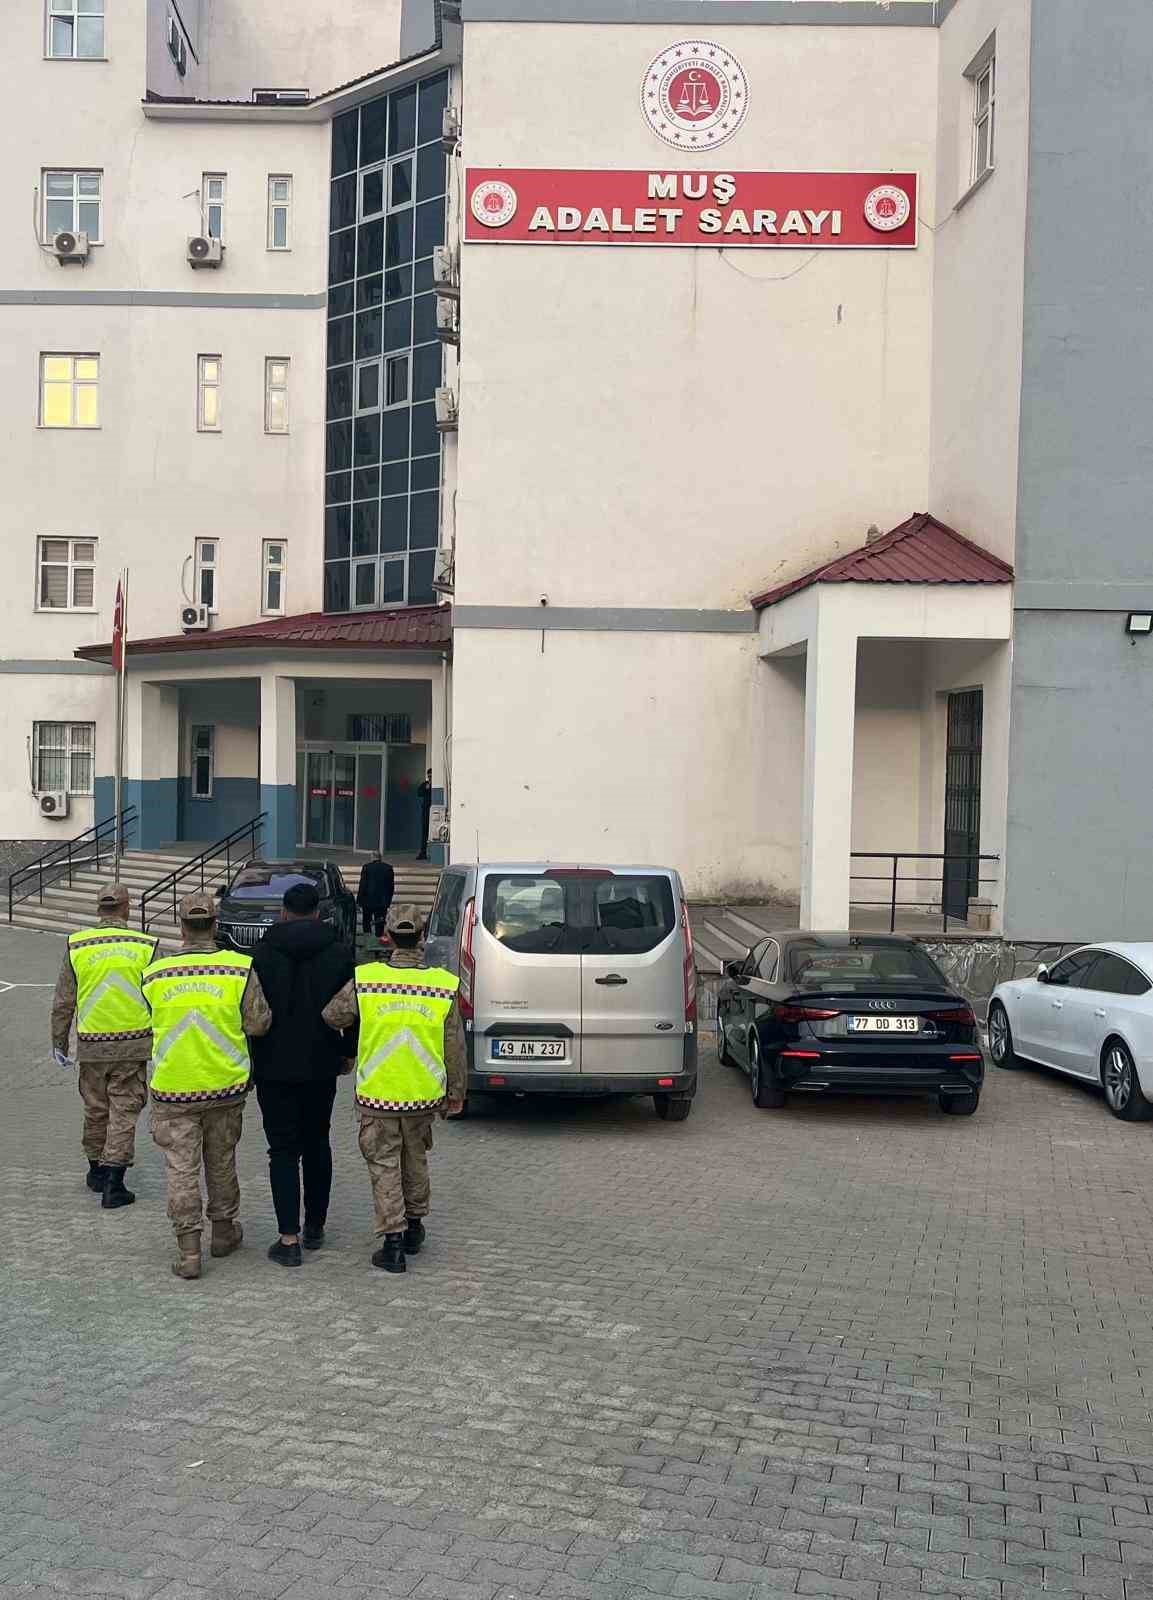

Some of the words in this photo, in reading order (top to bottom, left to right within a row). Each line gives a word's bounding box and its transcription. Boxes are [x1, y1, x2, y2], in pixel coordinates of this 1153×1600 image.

[647, 173, 736, 205] MUŞ
[528, 205, 683, 233] ADALET
[699, 208, 843, 236] SARAYI
[162, 982, 224, 1001] JANDARMA
[855, 1018, 868, 1030] 77
[876, 1018, 890, 1030] DD
[896, 1018, 915, 1030] 313
[500, 1042, 514, 1054] 49
[520, 1043, 534, 1055] AN
[541, 1043, 562, 1055] 237
